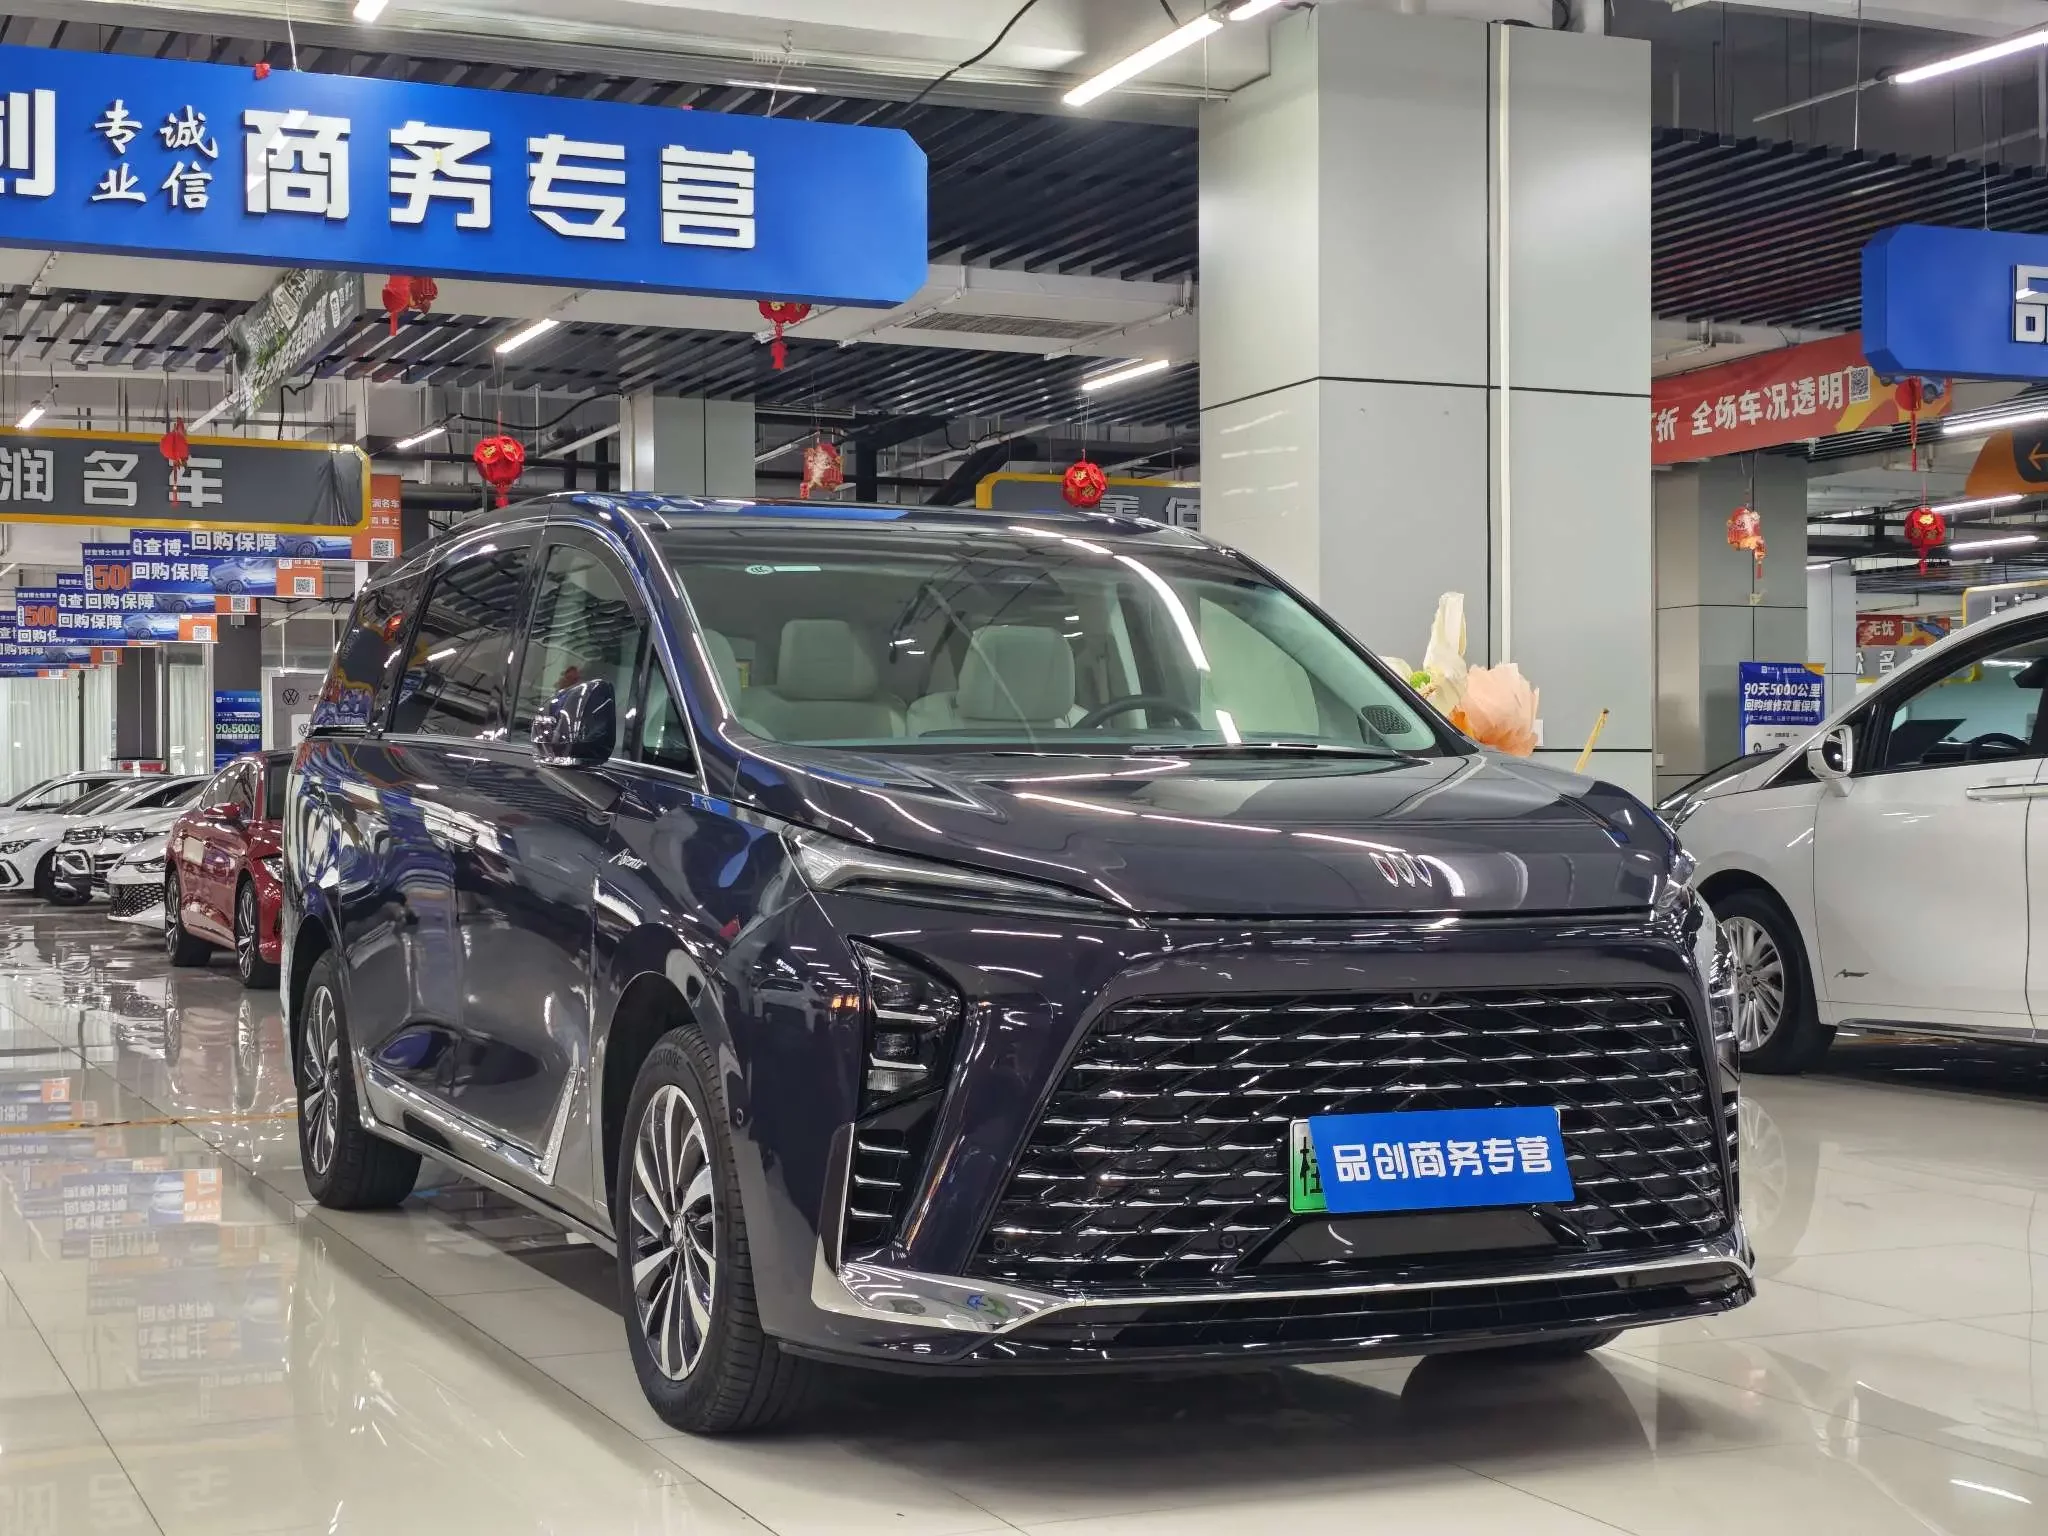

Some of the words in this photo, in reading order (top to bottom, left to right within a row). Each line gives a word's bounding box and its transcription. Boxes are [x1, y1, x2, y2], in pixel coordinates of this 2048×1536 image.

[243, 107, 756, 250] 商务专营
[1691, 371, 1844, 436] 全场车况透明
[1651, 406, 1680, 443] 折
[0, 448, 224, 508] 润名车
[143, 538, 189, 557] 查博
[191, 531, 278, 553] 回购保障
[131, 561, 210, 582] 回购保障
[85, 593, 156, 611] 回购保障
[58, 613, 123, 630] 回购保障
[1744, 682, 1821, 698] 90天5000公里
[1744, 698, 1821, 713] 回购维修双重保障
[1332, 1135, 1552, 1183] 品创商务专营
